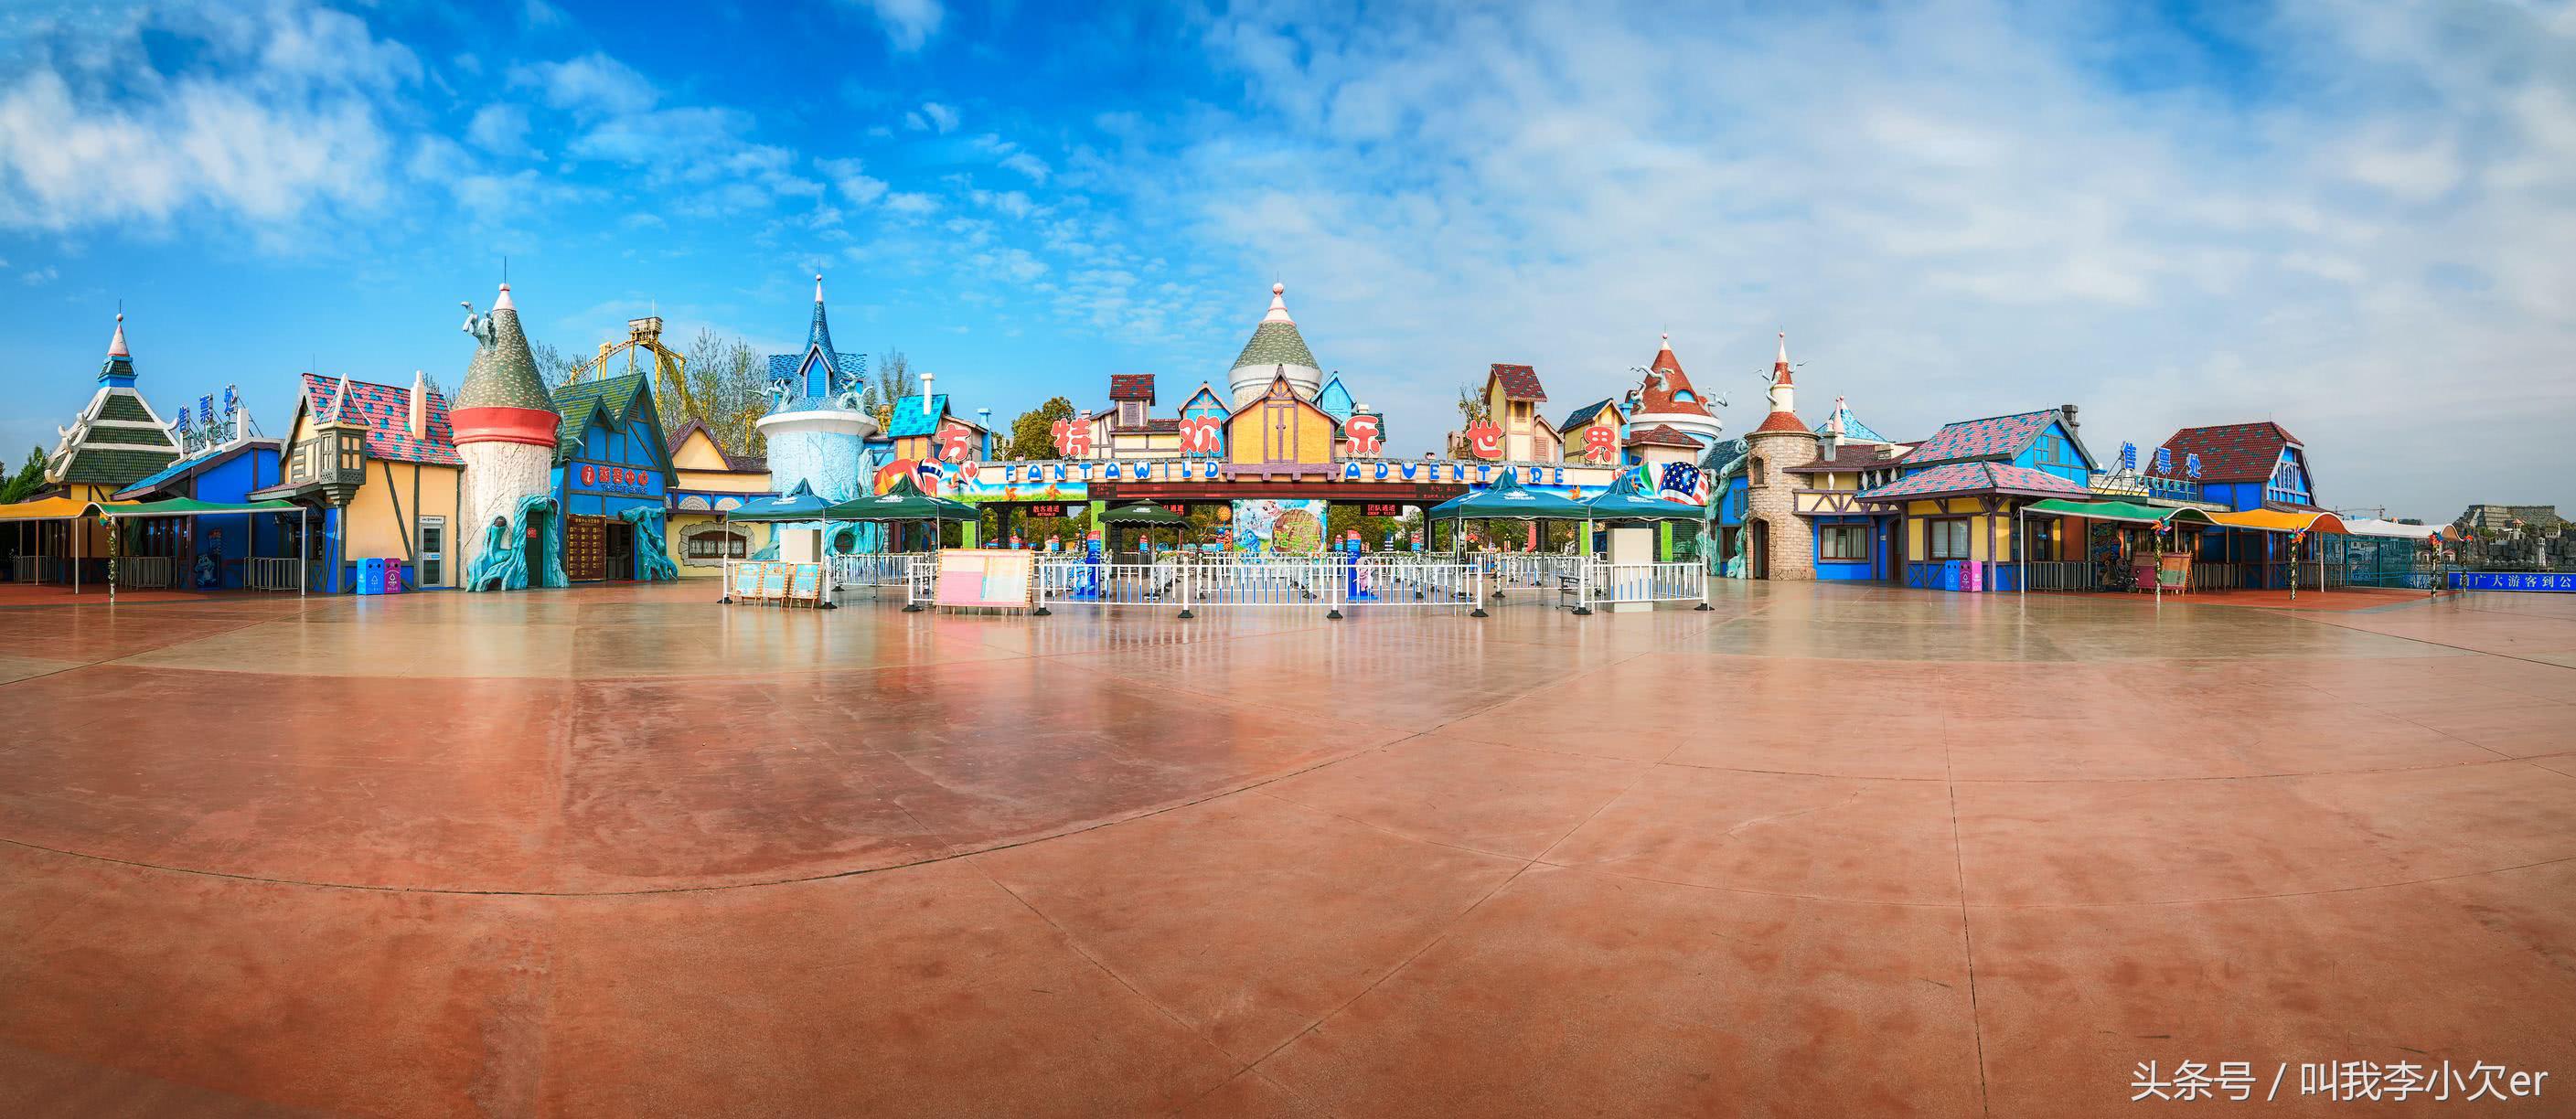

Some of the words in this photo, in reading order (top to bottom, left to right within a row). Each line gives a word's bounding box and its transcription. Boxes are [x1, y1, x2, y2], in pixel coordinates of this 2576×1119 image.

[178, 383, 237, 433] 售票处
[938, 414, 1617, 462] 方特欢乐世界
[1006, 462, 1219, 481] FANTAWILD
[2122, 441, 2202, 479] 售票处
[599, 465, 648, 485] 游客中心
[1367, 504, 1396, 512] 团队通道
